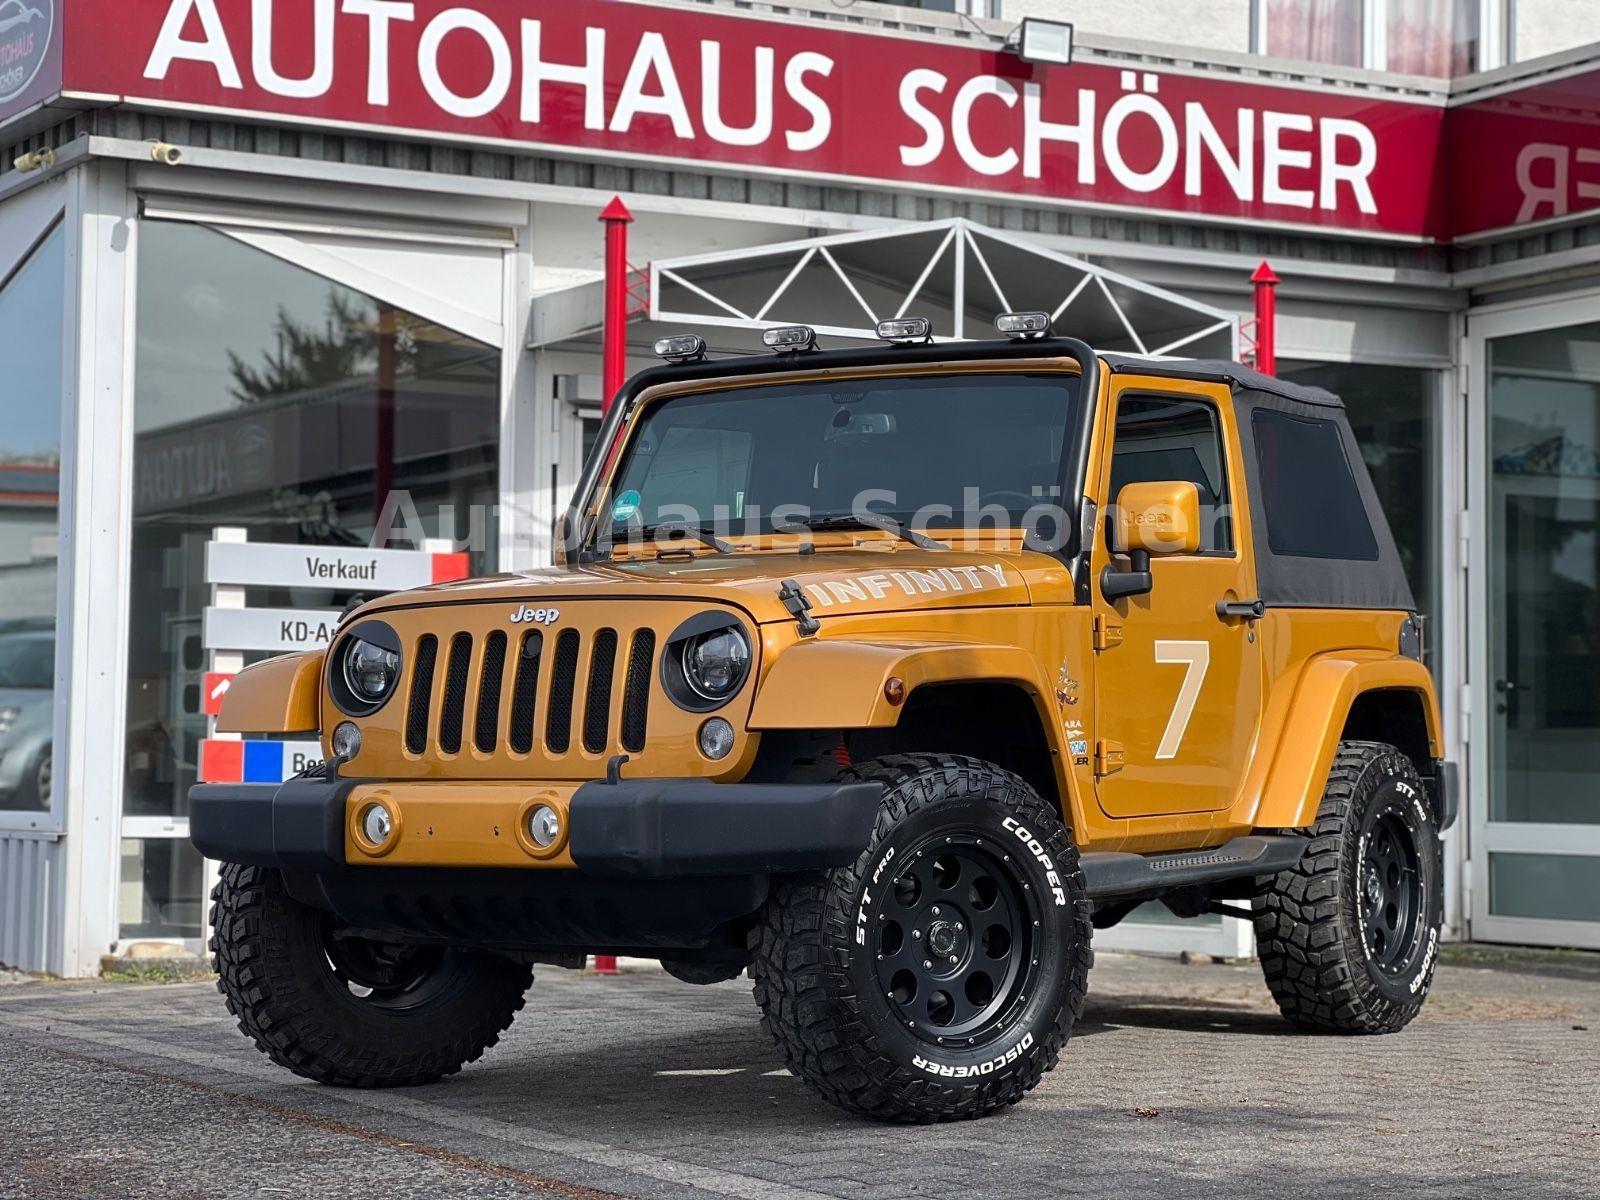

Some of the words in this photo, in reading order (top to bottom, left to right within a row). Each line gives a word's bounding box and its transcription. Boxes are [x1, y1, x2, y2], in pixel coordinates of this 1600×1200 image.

[0, 31, 34, 67] TOHAUS
[143, 0, 833, 152] AUTOHAUS
[899, 70, 1378, 214] SCHÖNER
[1124, 511, 1168, 528] Jeep
[306, 557, 377, 580] Verkauf
[805, 563, 1009, 607] INFINITY
[510, 604, 560, 627] Jeep
[1155, 640, 1210, 759] 7
[1395, 781, 1415, 798] STT
[1413, 799, 1426, 821] PRO
[1002, 816, 1066, 907] COOPER
[856, 886, 871, 946] STT
[873, 846, 895, 885] PRO
[1409, 927, 1437, 994] COOPER
[912, 1031, 1034, 1079] DISCOVERER
